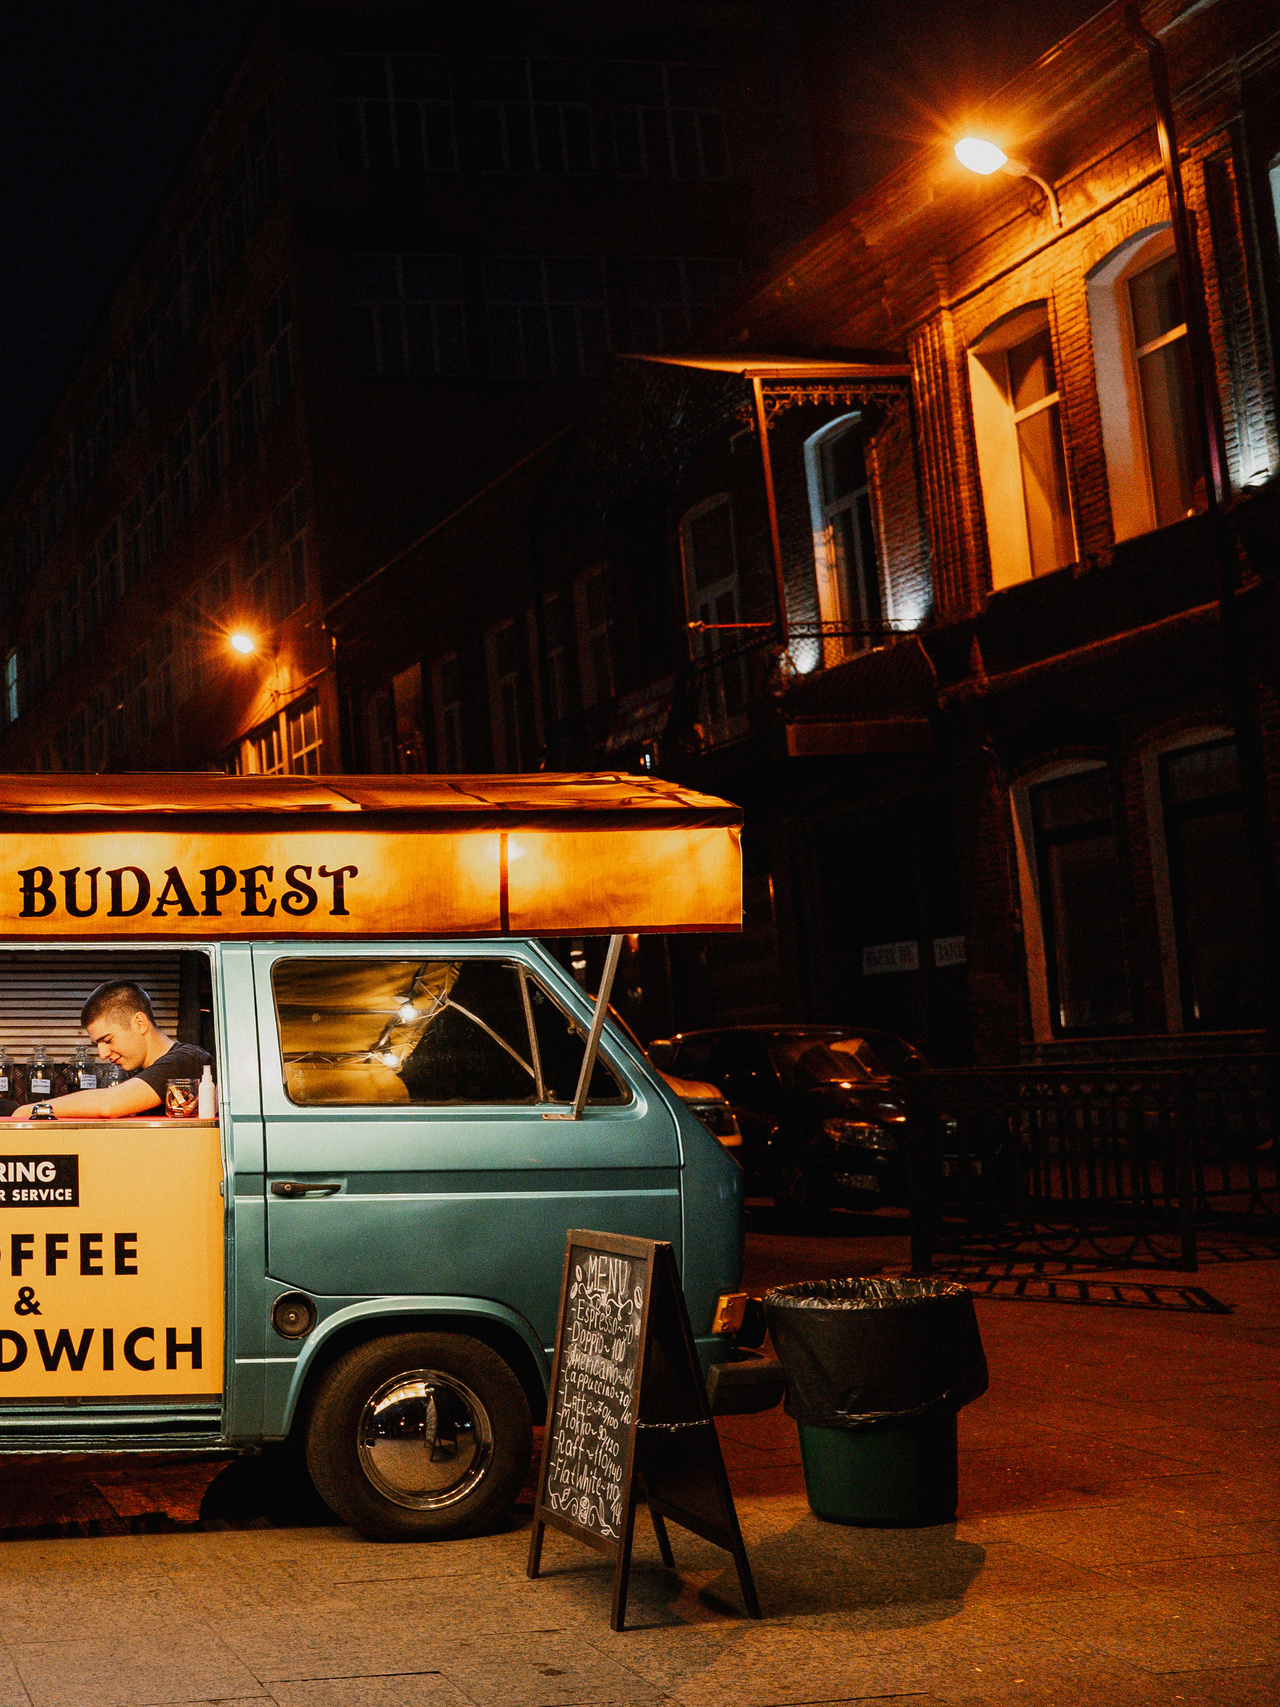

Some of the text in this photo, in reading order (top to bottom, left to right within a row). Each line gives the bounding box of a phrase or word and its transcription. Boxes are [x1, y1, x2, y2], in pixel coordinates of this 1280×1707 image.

[17, 864, 359, 918] BUDAPEST
[12, 1188, 72, 1202] SERVICE
[586, 1254, 629, 1295] MENU
[14, 1286, 43, 1316] &
